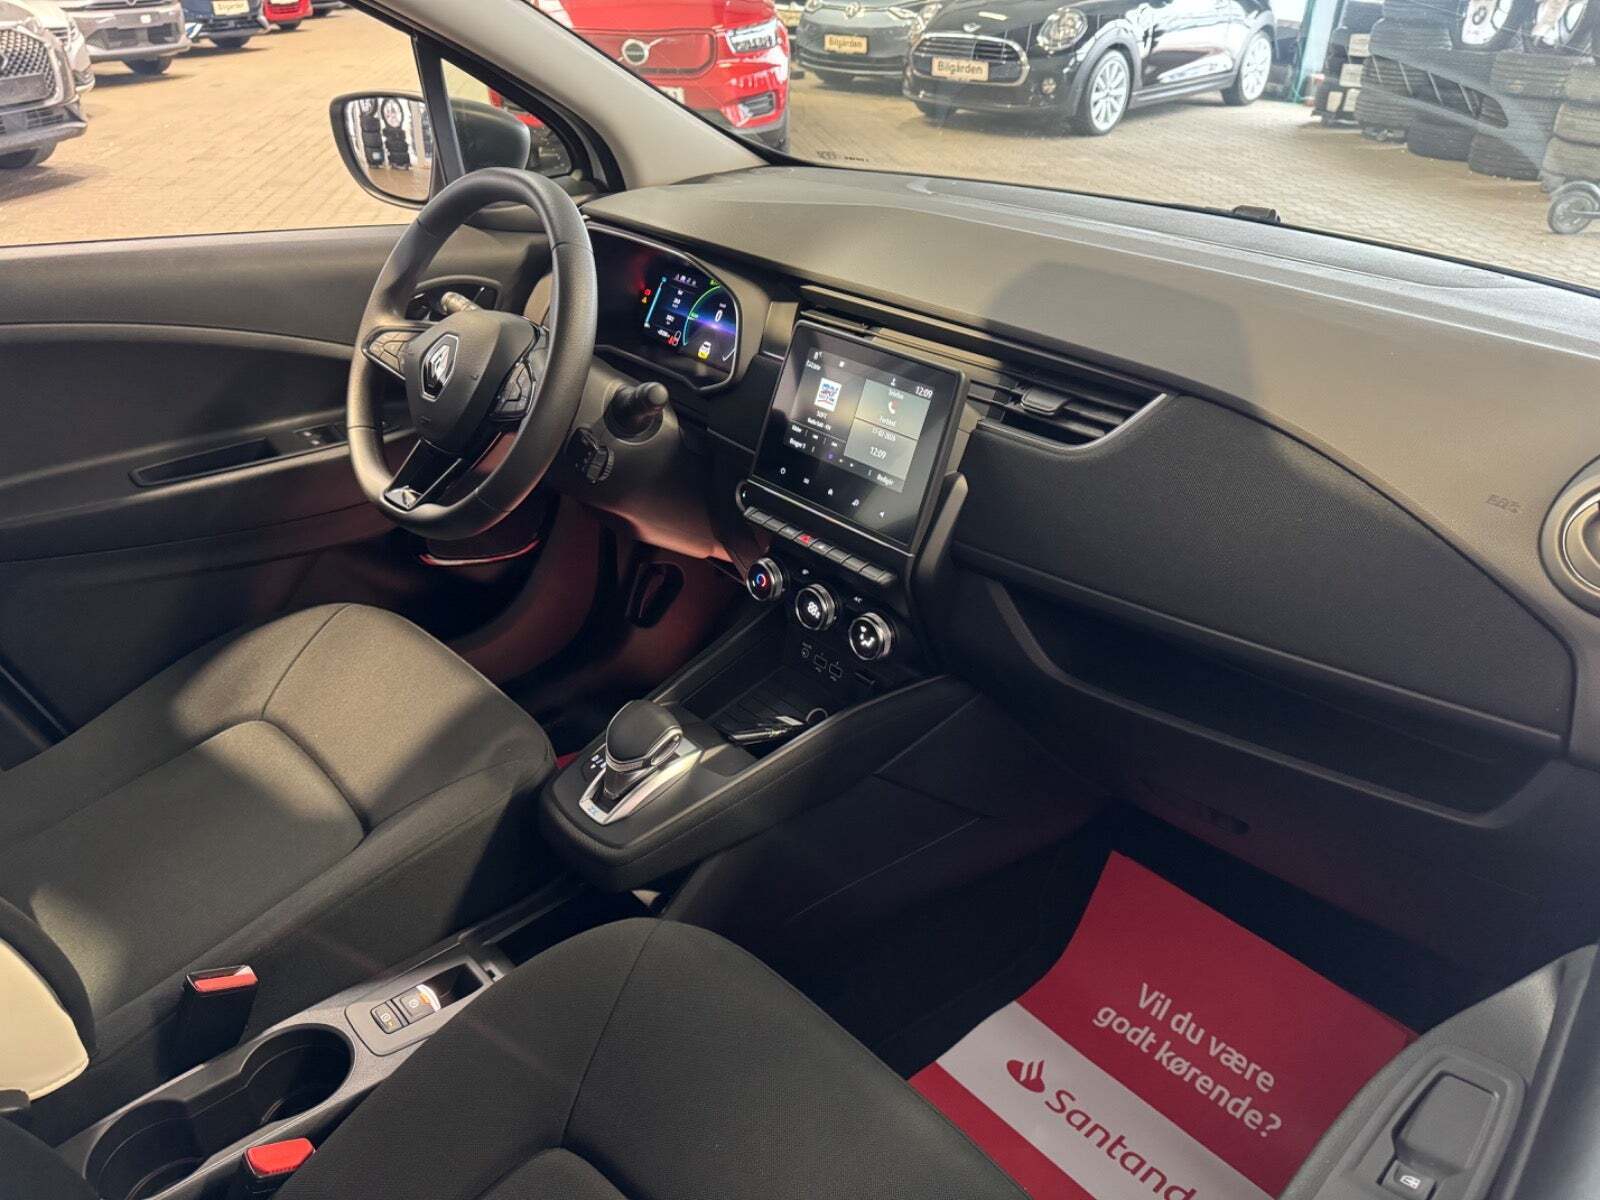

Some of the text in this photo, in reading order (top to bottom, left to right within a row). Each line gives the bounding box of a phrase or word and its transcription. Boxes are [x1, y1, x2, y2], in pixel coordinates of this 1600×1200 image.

[829, 36, 863, 49] Bilgården
[937, 60, 983, 75] Bilgården
[915, 384, 934, 399] 12:09
[869, 445, 887, 460] 12:09
[1137, 982, 1275, 1093] Vil du være
[1092, 1006, 1283, 1138] godt kørende?
